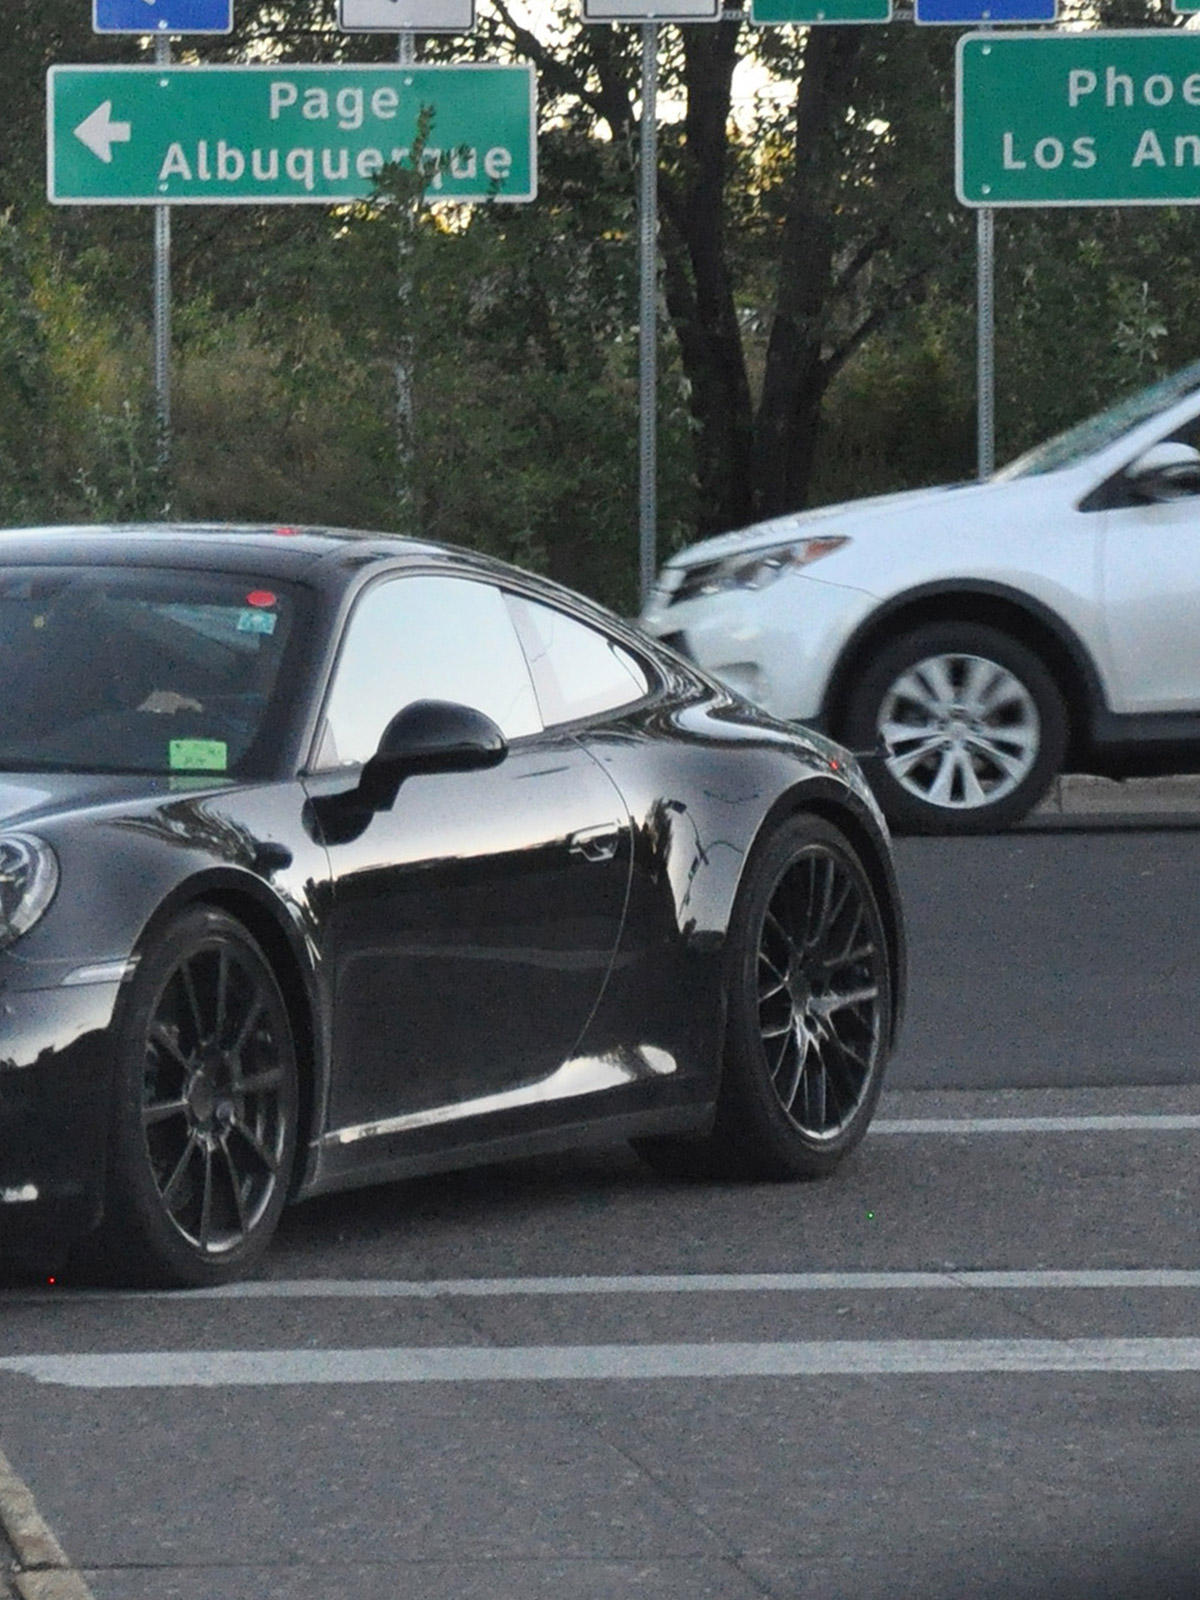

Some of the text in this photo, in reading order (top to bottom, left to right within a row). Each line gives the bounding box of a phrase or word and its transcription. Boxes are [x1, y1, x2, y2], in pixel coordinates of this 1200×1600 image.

[269, 81, 399, 130] Page
[1068, 65, 1200, 107] Phoe
[1003, 128, 1200, 170] Los An
